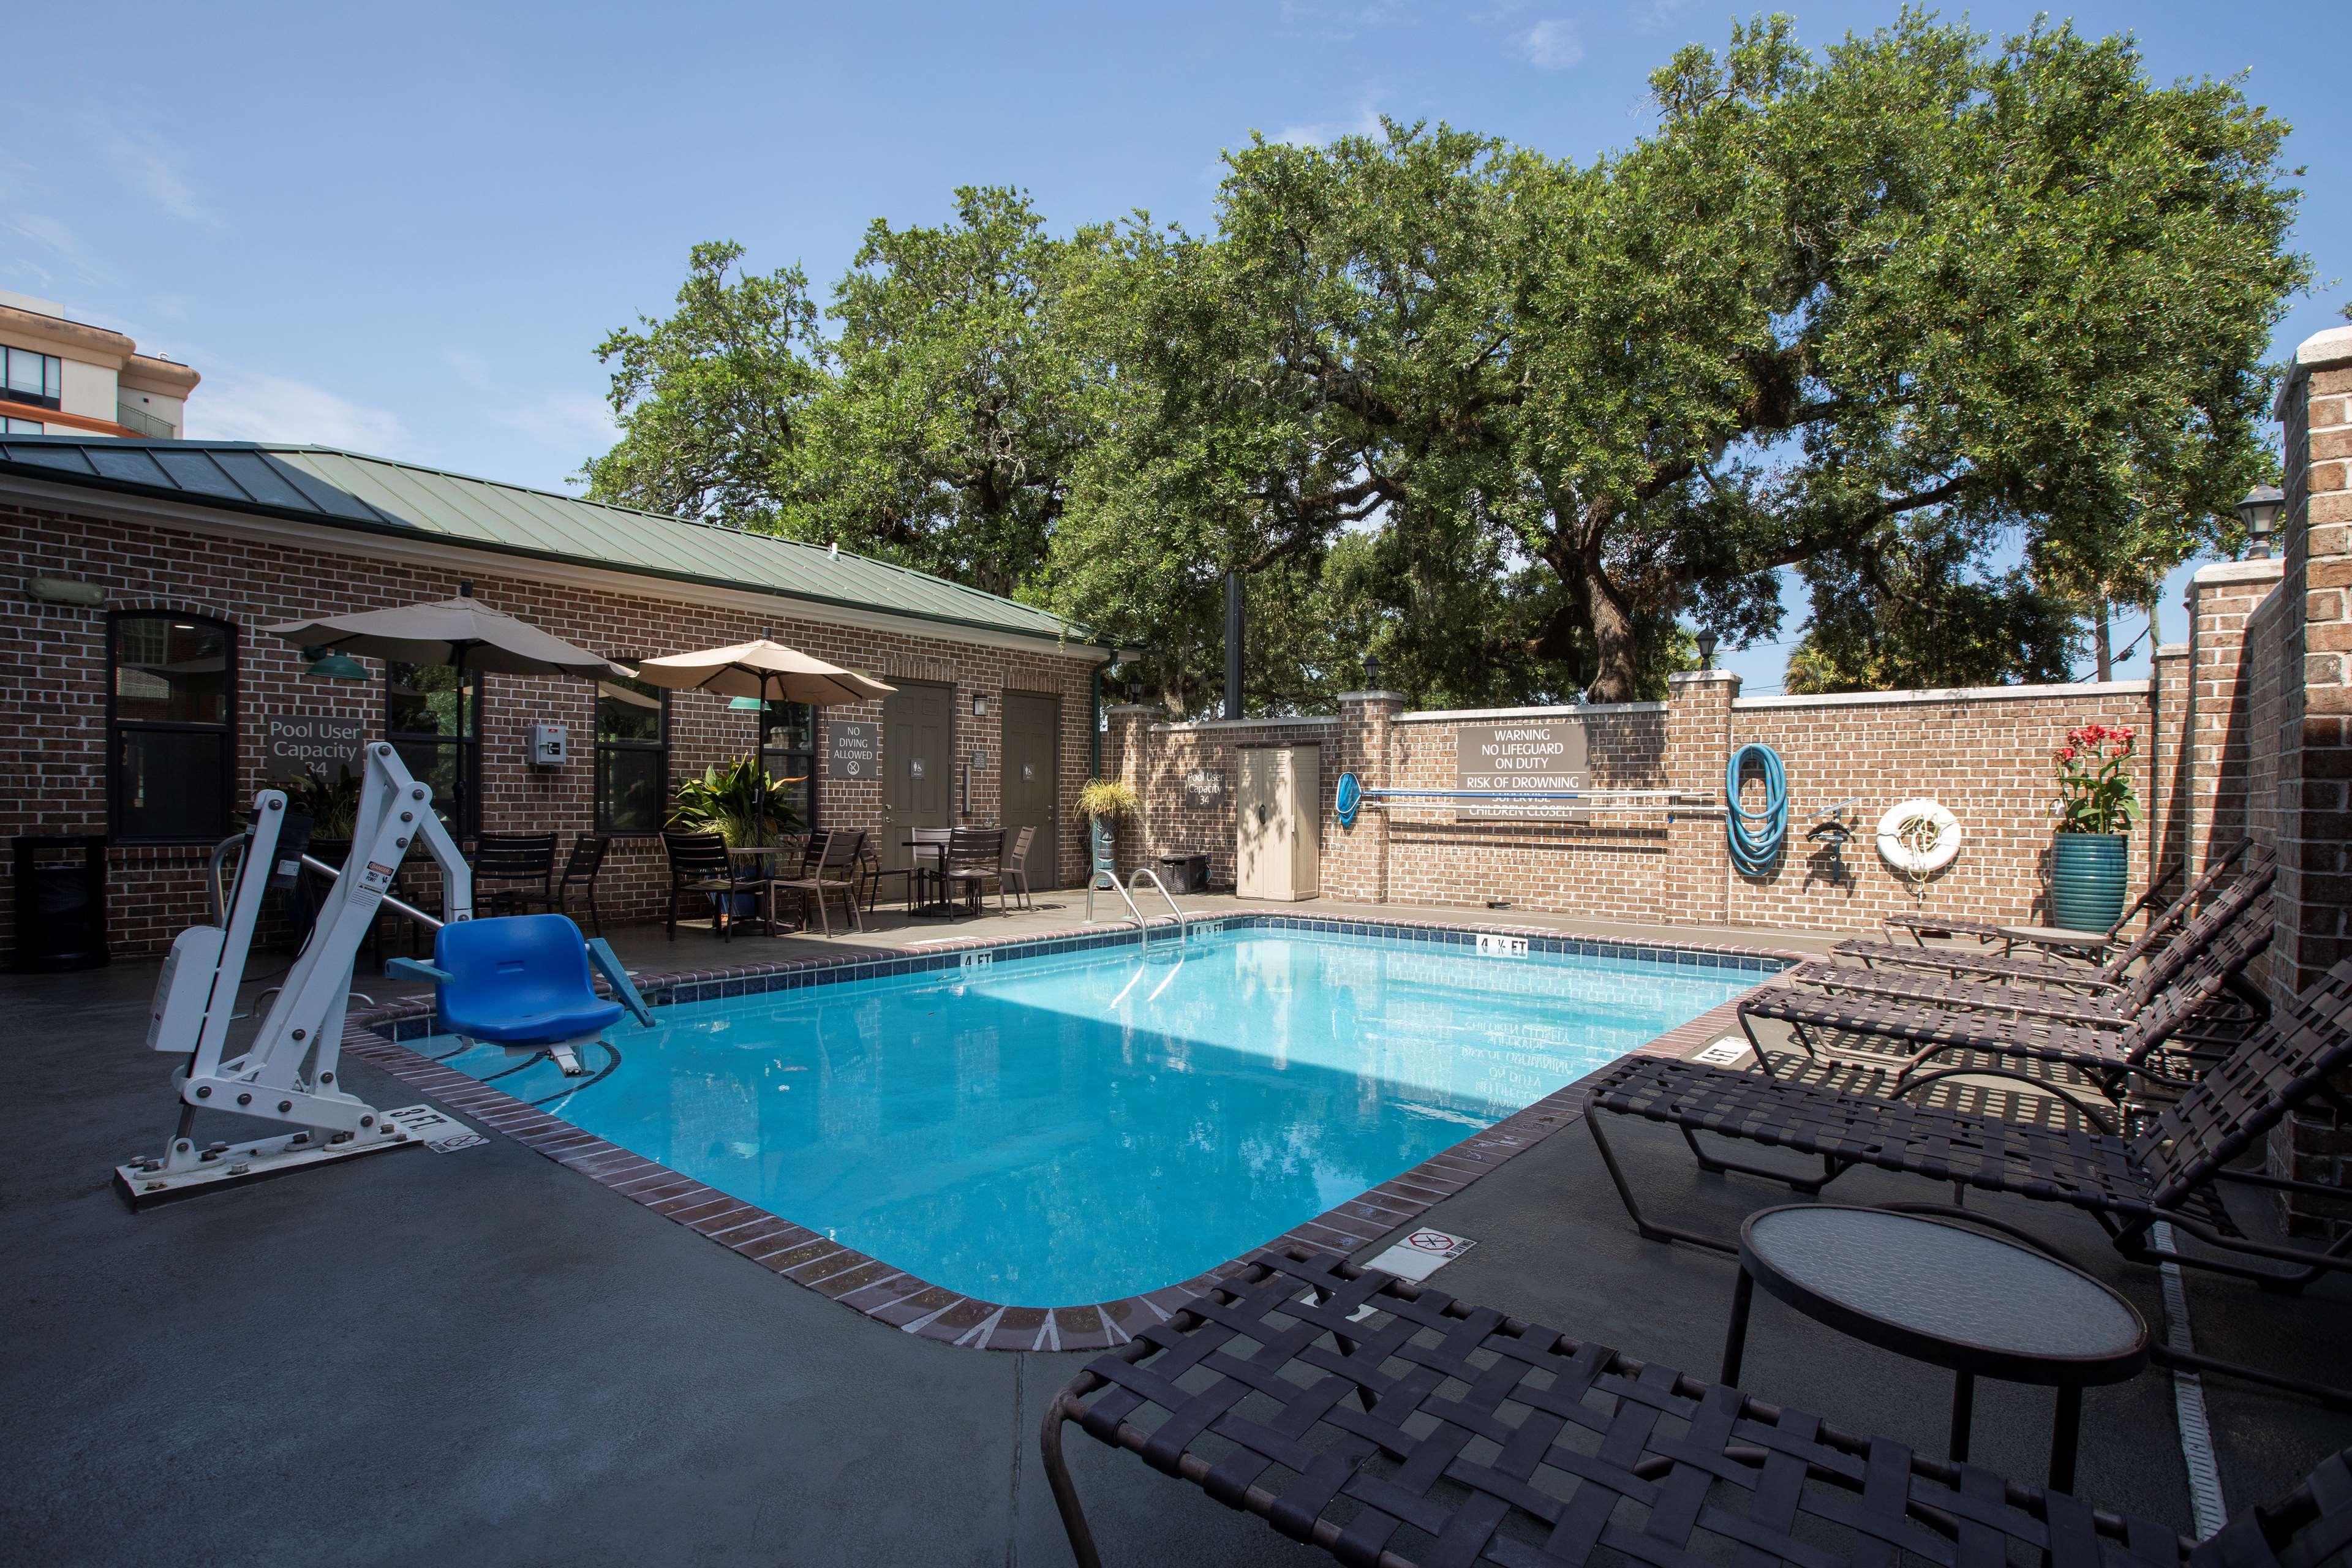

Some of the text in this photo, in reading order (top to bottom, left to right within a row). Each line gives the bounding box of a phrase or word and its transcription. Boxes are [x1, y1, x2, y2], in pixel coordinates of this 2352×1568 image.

[270, 721, 361, 740] Pool User
[847, 726, 860, 736] NO
[1494, 729, 1550, 741] WARNING
[839, 738, 868, 748] DIVING
[1482, 742, 1564, 755] NO LIFEGUARD
[274, 741, 357, 762] Capacity
[834, 750, 872, 760] ALLOWED
[1495, 757, 1549, 769] ON DUTY
[1187, 772, 1224, 782] Pool User
[1467, 776, 1579, 788] RISK OF DROWNING
[1189, 783, 1223, 796] Capacity
[1200, 795, 1210, 805] 34
[1469, 804, 1575, 816] CHILDREN CLOSELY
[965, 953, 991, 966] 4 FT
[390, 1108, 427, 1117] 3
[1450, 1240, 1474, 1253] DIVING
